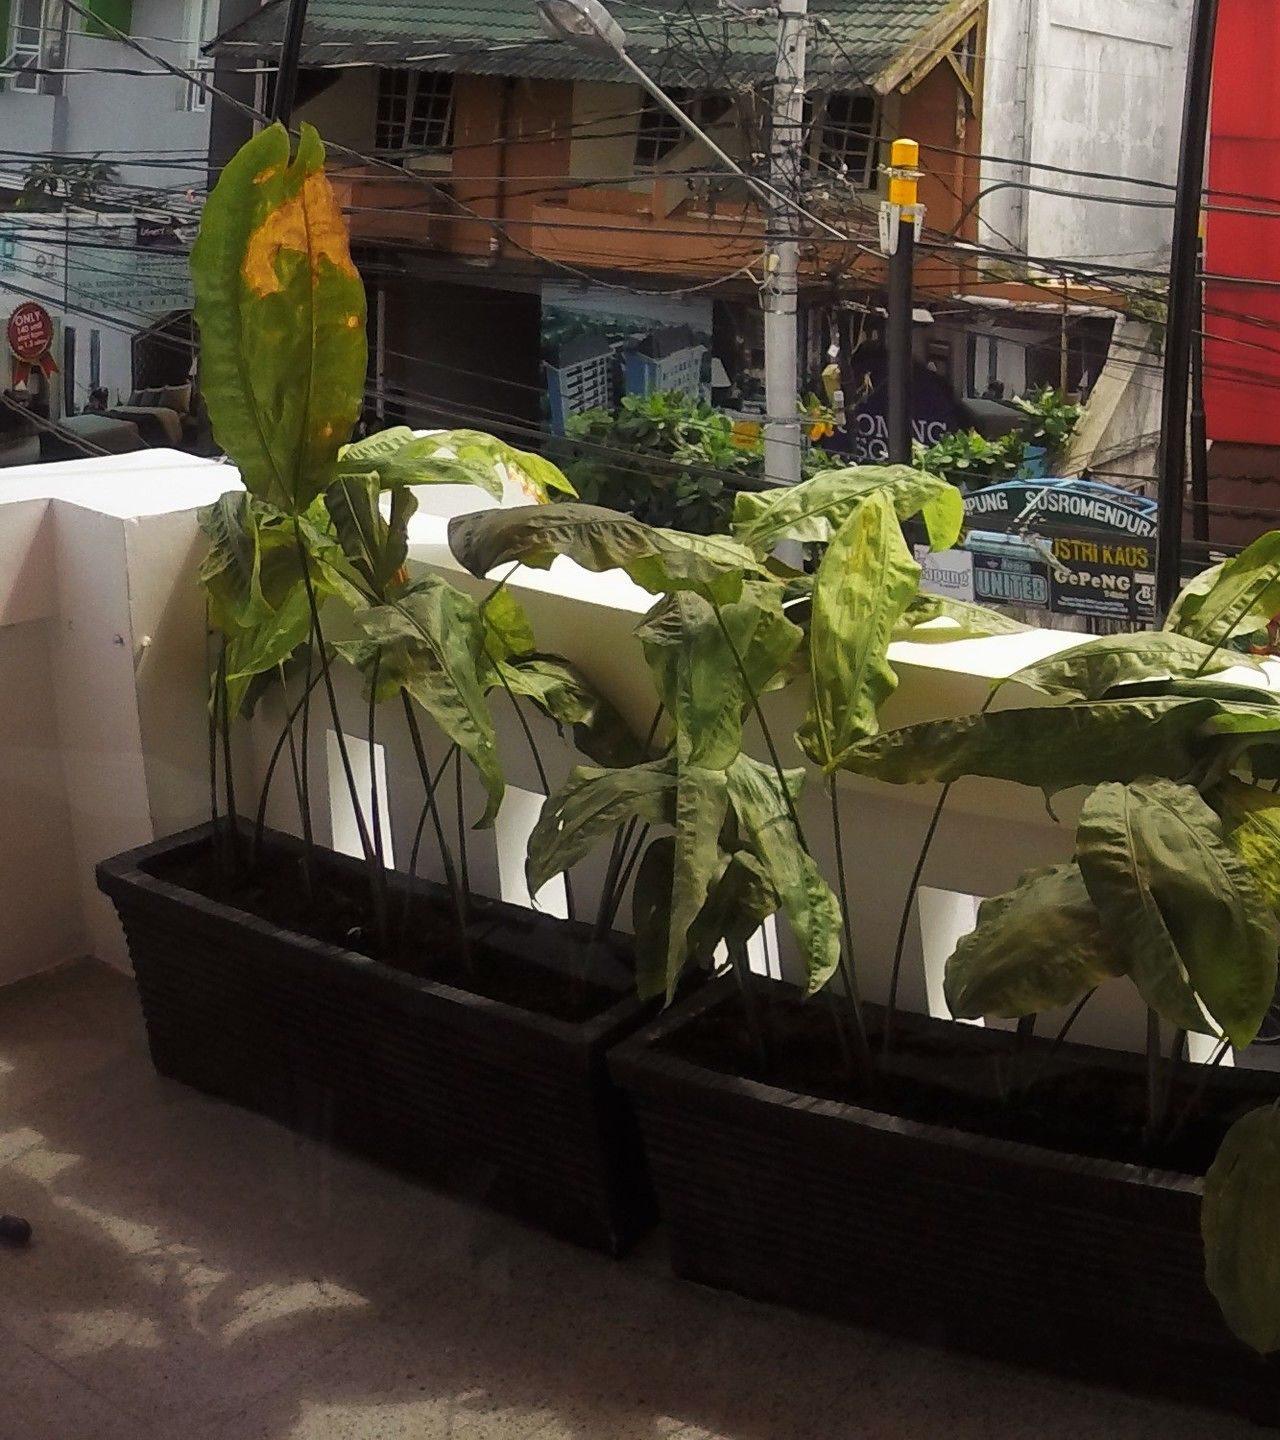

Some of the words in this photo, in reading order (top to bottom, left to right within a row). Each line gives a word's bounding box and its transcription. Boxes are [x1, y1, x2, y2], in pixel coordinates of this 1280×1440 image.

[15, 311, 42, 327] ONLY
[963, 492, 1008, 513] PUNG
[1103, 546, 1149, 569] KAUS
